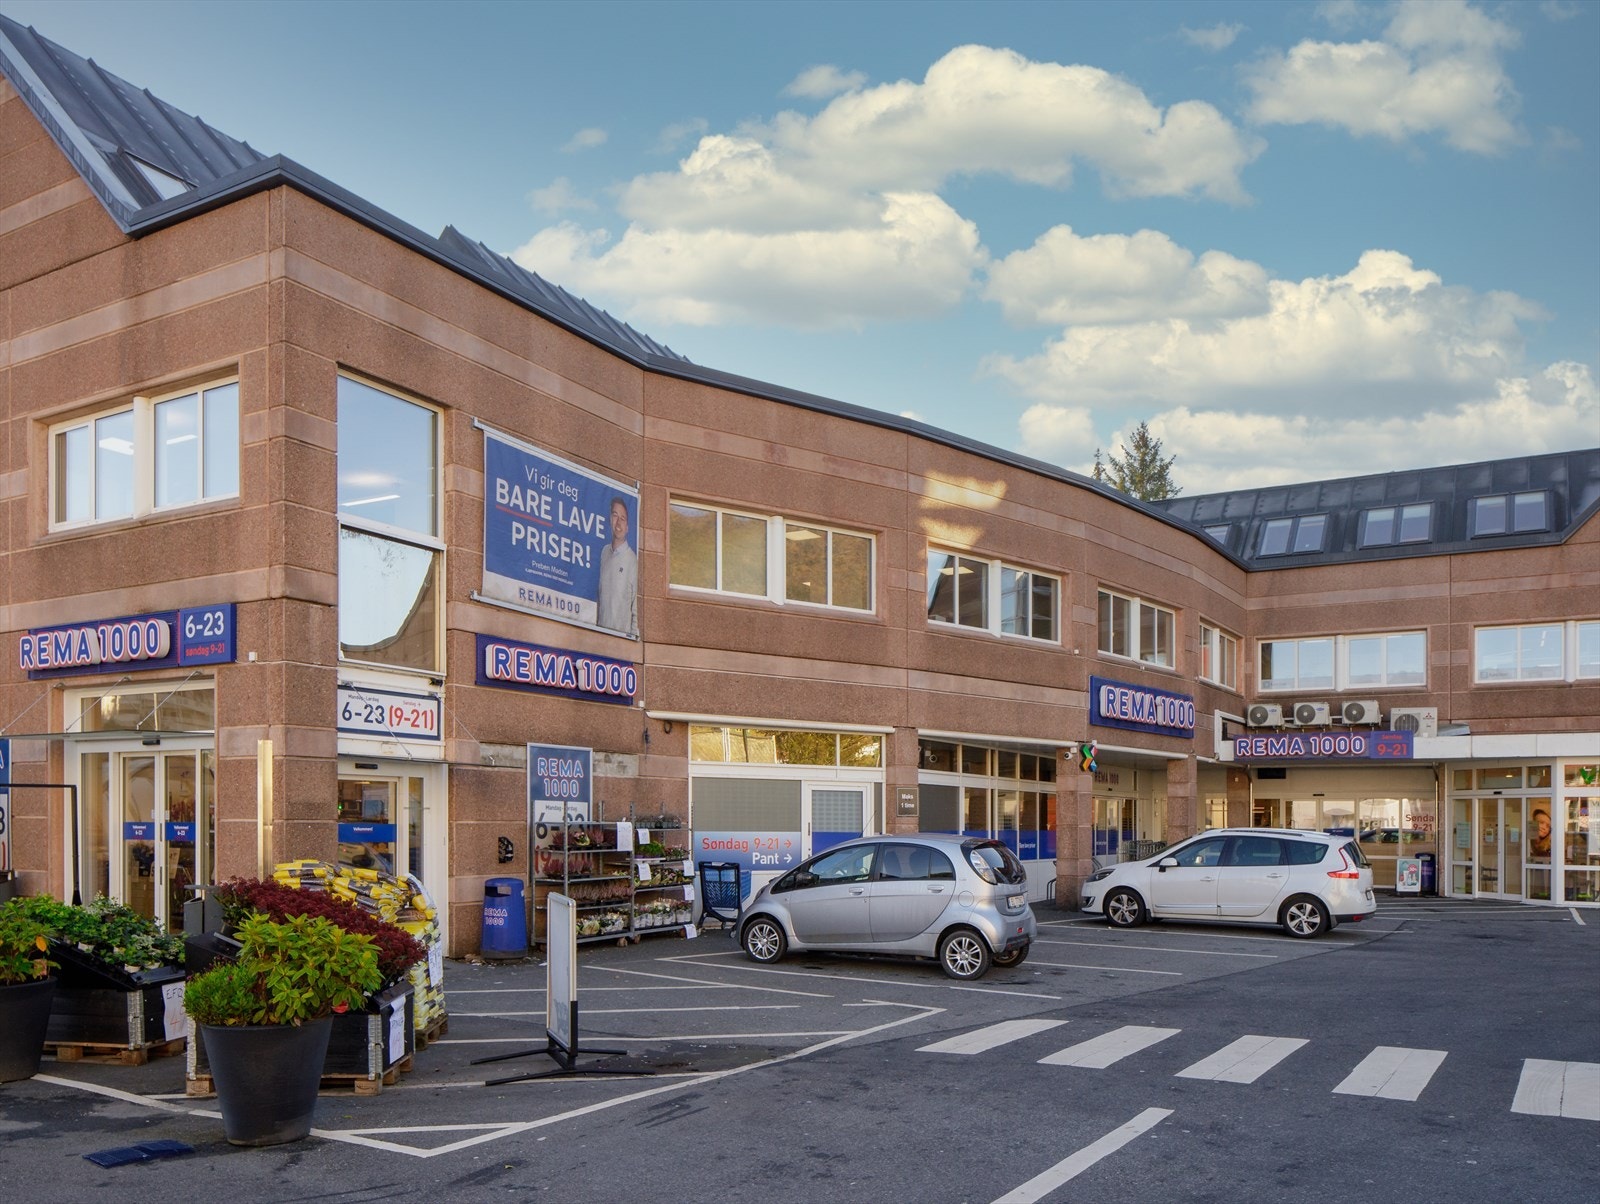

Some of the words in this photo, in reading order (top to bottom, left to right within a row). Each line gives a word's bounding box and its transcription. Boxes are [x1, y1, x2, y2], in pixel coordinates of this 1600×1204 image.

[525, 465, 538, 484] Vi
[540, 474, 555, 490] gir
[557, 480, 578, 502] deg
[496, 477, 552, 520] BARE
[558, 500, 606, 539] LAVE
[511, 521, 592, 569] PRISER!
[518, 588, 553, 608] REMA
[555, 597, 580, 614] 1000
[185, 611, 225, 639] 6-23
[20, 627, 93, 670] REMA
[97, 618, 162, 661] 1000
[491, 643, 578, 690] REMA
[580, 659, 638, 697] 1000
[341, 701, 386, 725] 6-23
[388, 704, 435, 732] (9-21)
[1105, 685, 1157, 725] REMA
[1159, 695, 1195, 729] 1000
[1235, 736, 1305, 757] REMA
[1308, 735, 1366, 756] 1000
[1377, 743, 1407, 756] 9-21
[537, 757, 584, 778] REMA
[543, 777, 580, 798] 1000
[1412, 823, 1433, 832] 9-21
[702, 837, 749, 853] Søndag
[753, 837, 779, 850] 9-21
[752, 852, 779, 865] Pant
